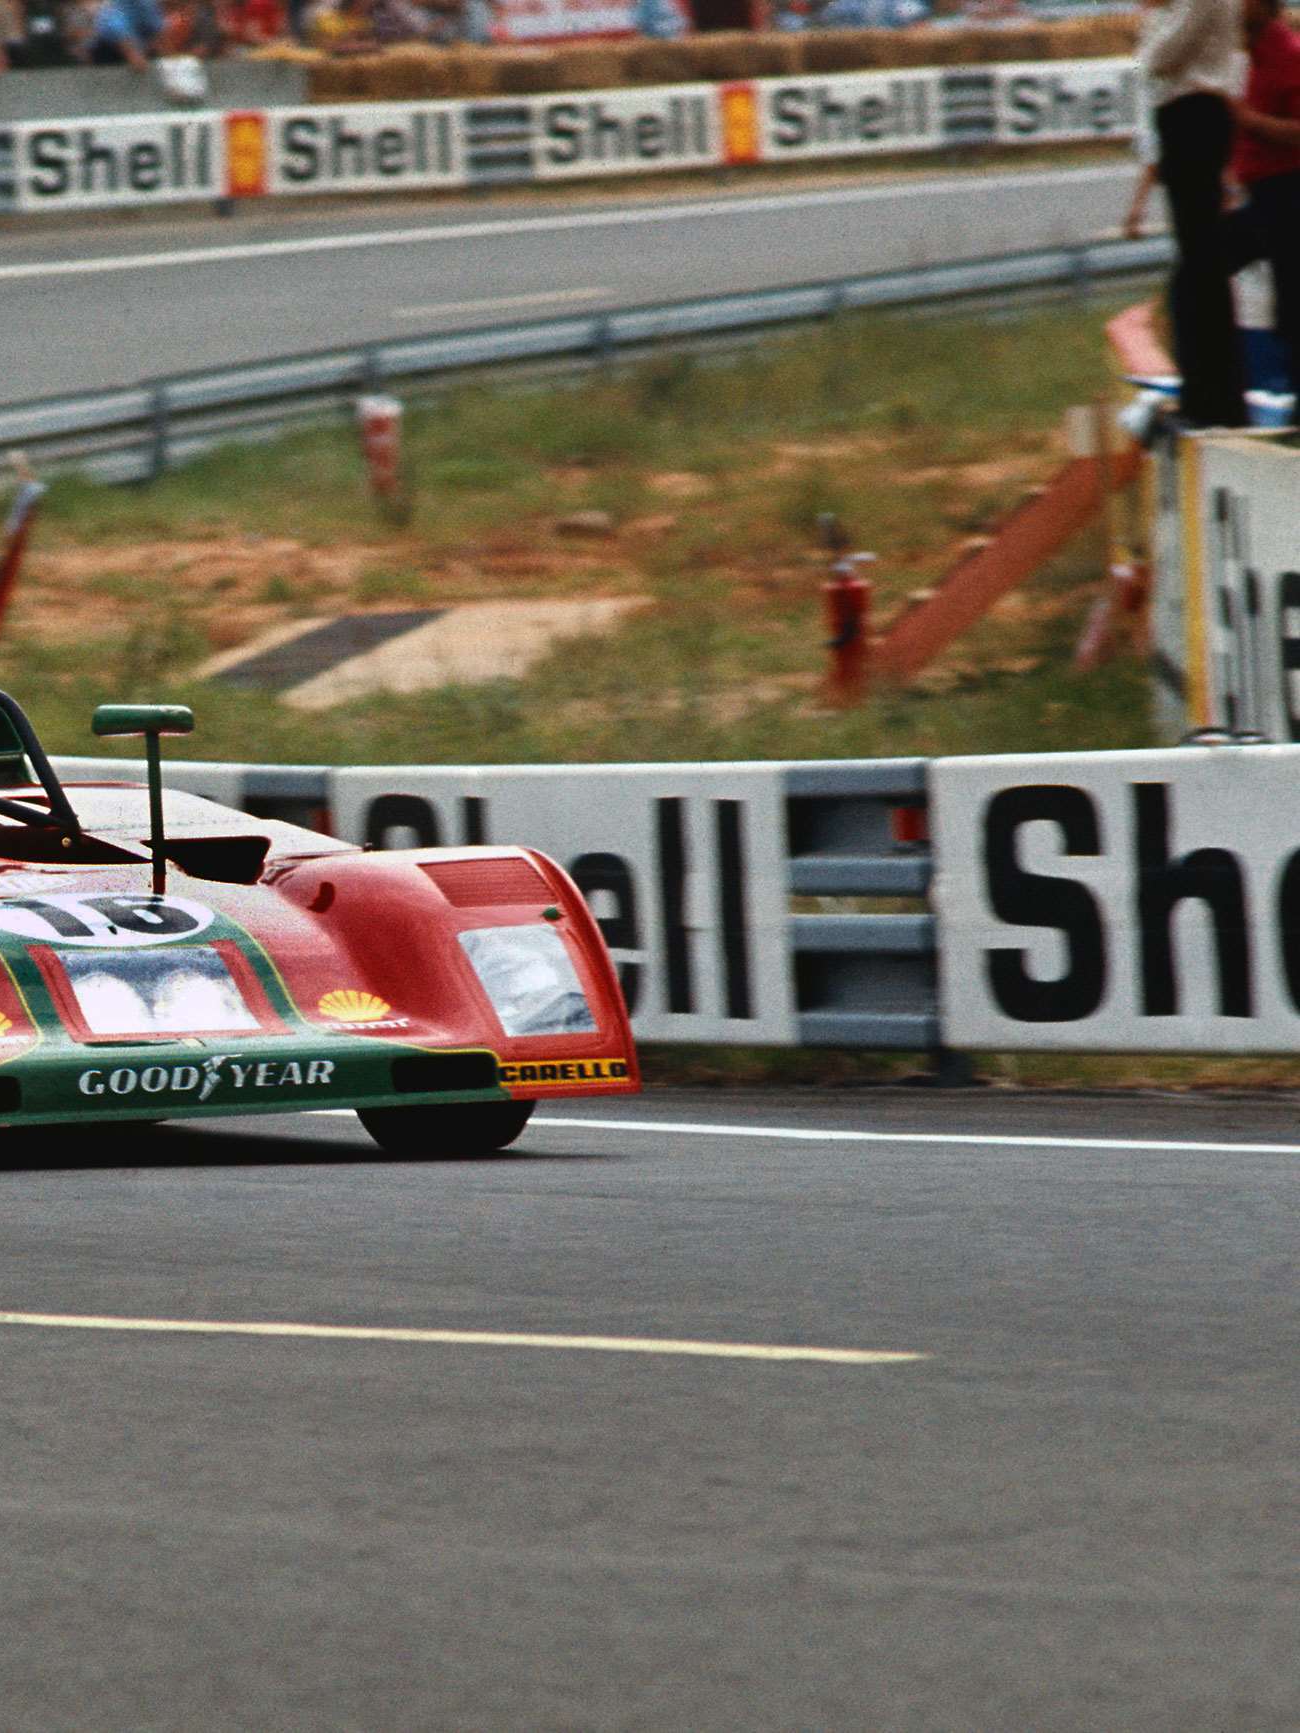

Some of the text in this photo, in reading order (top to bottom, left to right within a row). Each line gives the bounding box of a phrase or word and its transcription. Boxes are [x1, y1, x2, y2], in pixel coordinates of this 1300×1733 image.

[543, 95, 707, 164] Shell
[772, 79, 931, 148] Shell
[1010, 68, 1134, 134] Shel
[27, 123, 210, 196] Shell
[281, 112, 453, 184] Shell
[2, 895, 200, 937] 16
[365, 793, 754, 1019] ell
[983, 781, 1300, 1023] Sh
[500, 1061, 628, 1082] CARELLO
